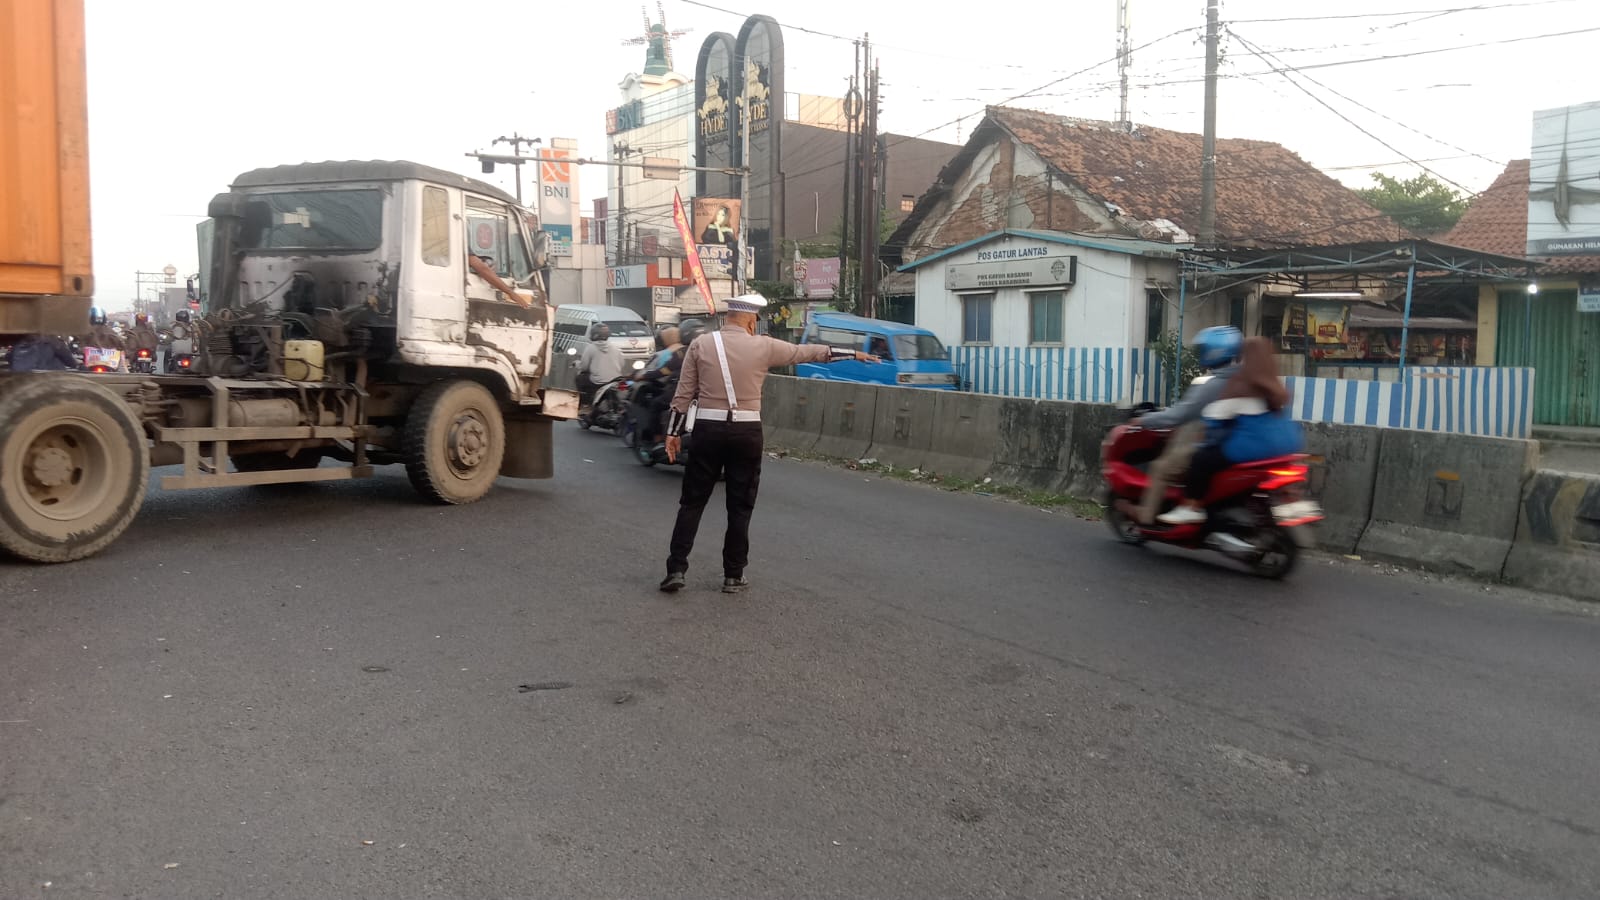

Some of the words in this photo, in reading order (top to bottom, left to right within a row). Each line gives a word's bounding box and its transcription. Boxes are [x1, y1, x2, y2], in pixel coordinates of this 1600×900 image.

[544, 185, 569, 198] BNI
[977, 251, 991, 260] POS
[993, 249, 1017, 260] GATUR
[1018, 247, 1047, 257] LANTAS
[615, 268, 630, 287] BNI
